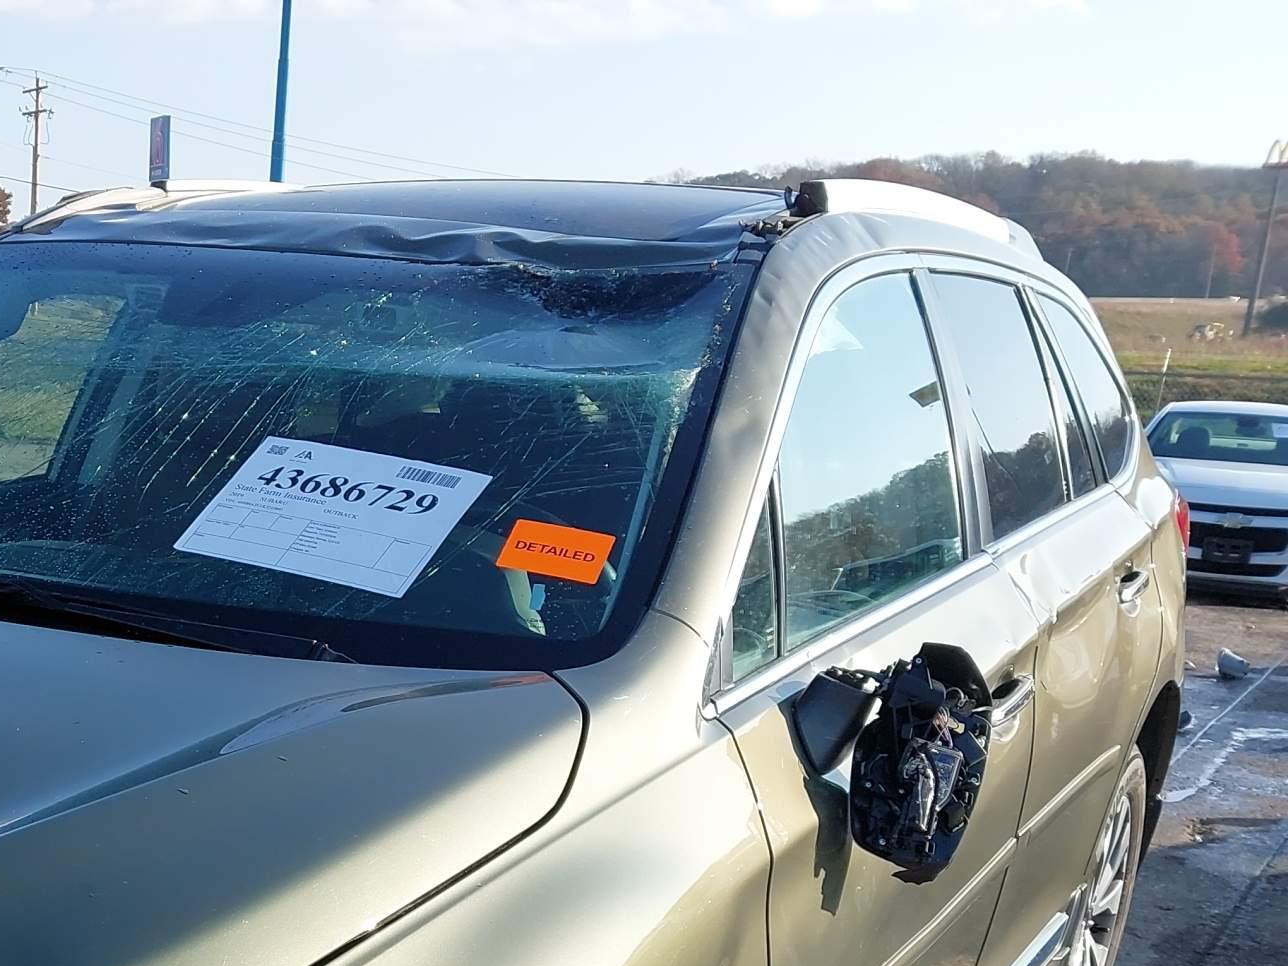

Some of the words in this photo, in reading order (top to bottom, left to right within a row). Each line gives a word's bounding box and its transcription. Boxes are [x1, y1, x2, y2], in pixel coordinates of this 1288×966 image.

[234, 483, 258, 493] State
[258, 487, 282, 498] Farm
[283, 490, 328, 506] Insurance
[257, 466, 439, 515] 43686729
[322, 508, 360, 520] OUTBACK
[514, 540, 596, 563] DETAILED
